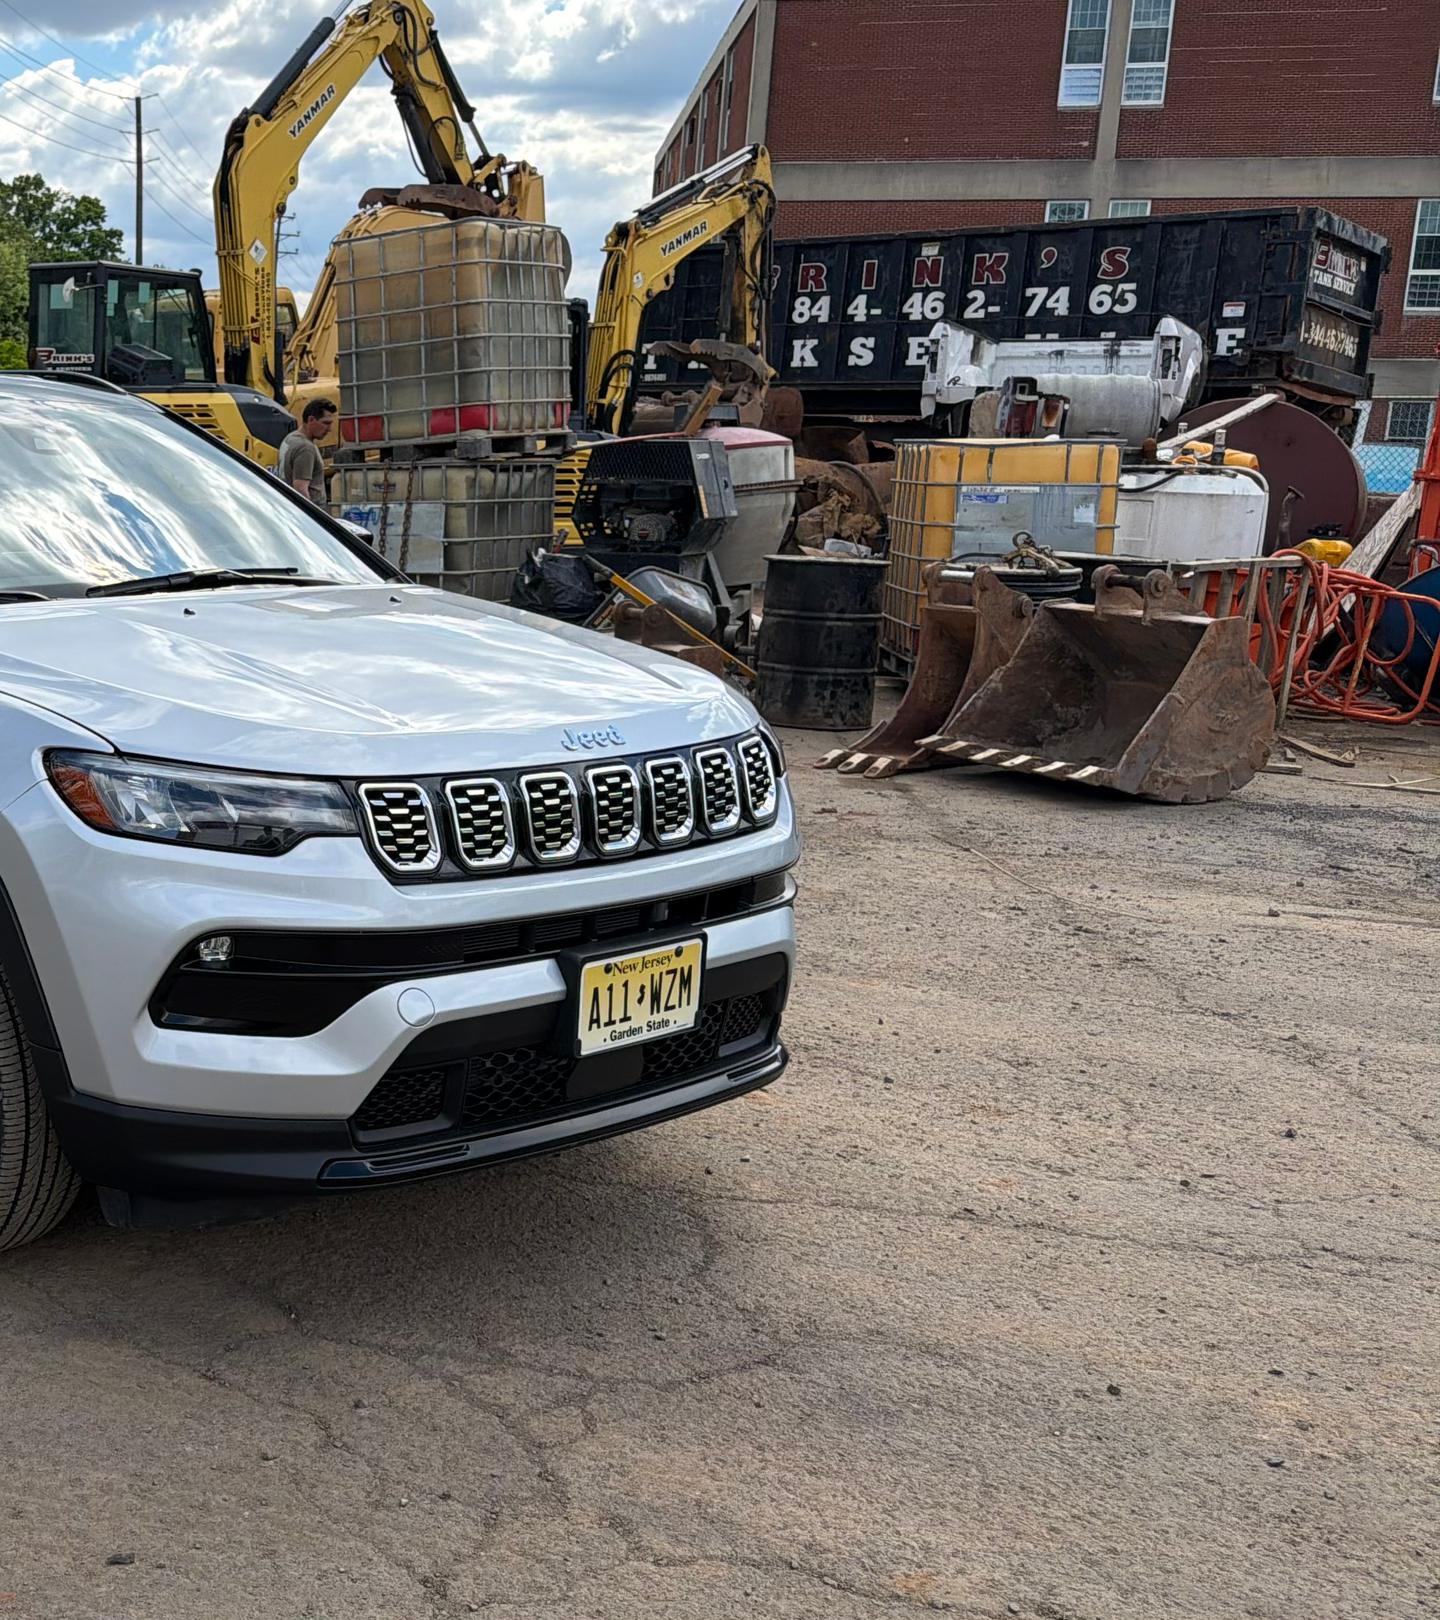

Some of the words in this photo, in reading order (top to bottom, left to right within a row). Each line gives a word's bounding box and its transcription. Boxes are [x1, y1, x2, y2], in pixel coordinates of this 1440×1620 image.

[288, 83, 336, 138] YANMAR
[660, 220, 708, 257] YANMAR
[612, 960, 640, 977] New
[639, 953, 674, 973] Jersey
[650, 964, 693, 1016] WZM
[609, 1024, 644, 1042] Garden
[646, 1017, 671, 1032] State
